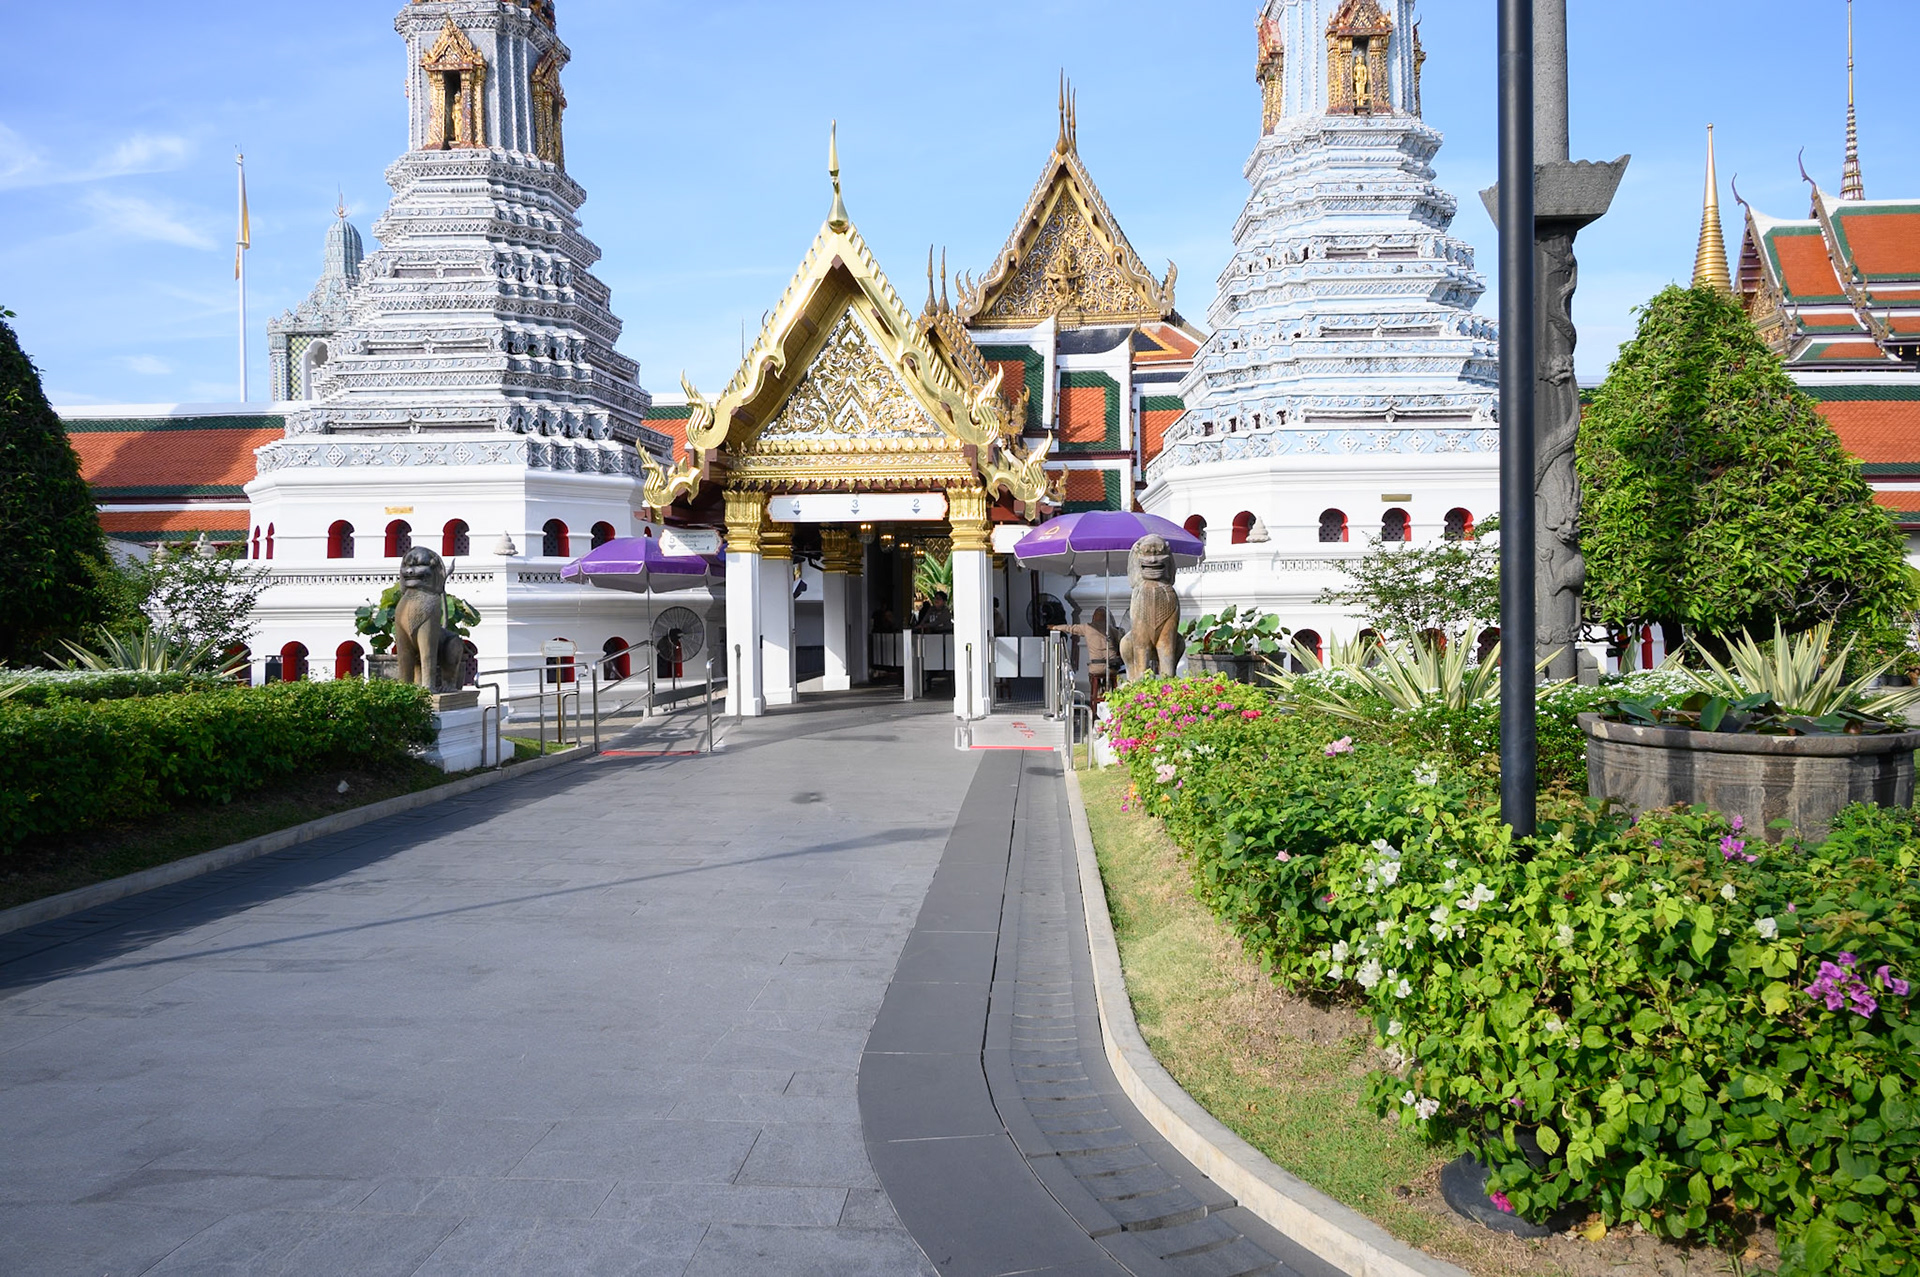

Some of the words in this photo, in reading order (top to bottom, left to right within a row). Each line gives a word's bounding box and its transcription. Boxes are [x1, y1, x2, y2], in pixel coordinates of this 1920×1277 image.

[794, 500, 801, 509] 4
[852, 499, 859, 508] 3
[913, 498, 920, 508] 2
[669, 535, 676, 544] 5
